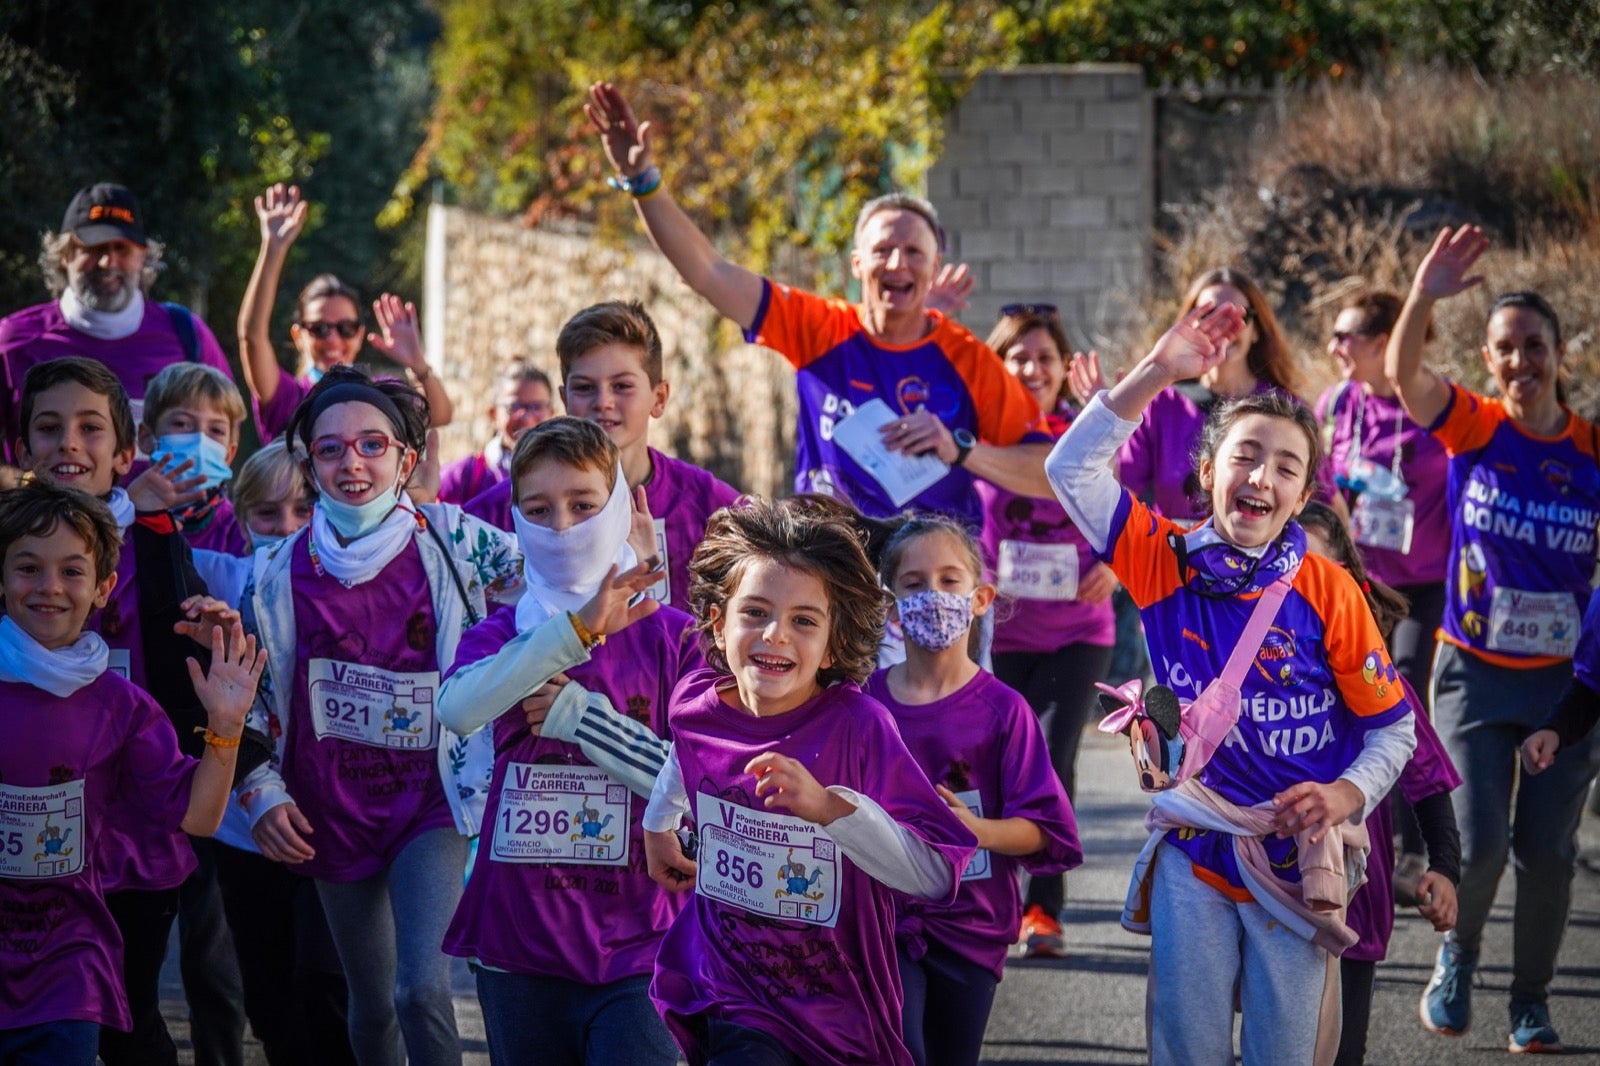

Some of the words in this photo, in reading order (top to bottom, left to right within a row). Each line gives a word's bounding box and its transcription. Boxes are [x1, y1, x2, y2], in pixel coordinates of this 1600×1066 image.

[1463, 501, 1537, 546] DONA
[1502, 620, 1539, 639] 849
[1260, 645, 1286, 662] aupa
[331, 662, 347, 682] V
[346, 675, 395, 693] CARRERA
[325, 698, 370, 726] 921
[1256, 719, 1336, 757] VIDA
[515, 765, 532, 789] V
[531, 780, 586, 792] CARRERA
[532, 771, 609, 782] #PonteEnMarchaYA
[502, 807, 570, 835] 1296
[719, 802, 735, 828] V
[736, 812, 816, 834] #PonteEnMarchaYA
[735, 821, 790, 843] CARRERA
[507, 839, 541, 848] IGNACIO
[526, 847, 562, 855] CORONADO
[715, 848, 764, 889] 856
[704, 883, 737, 900] RODRIGUEZ
[737, 895, 765, 909] CASTILLO
[719, 880, 747, 897] GABRIEL
